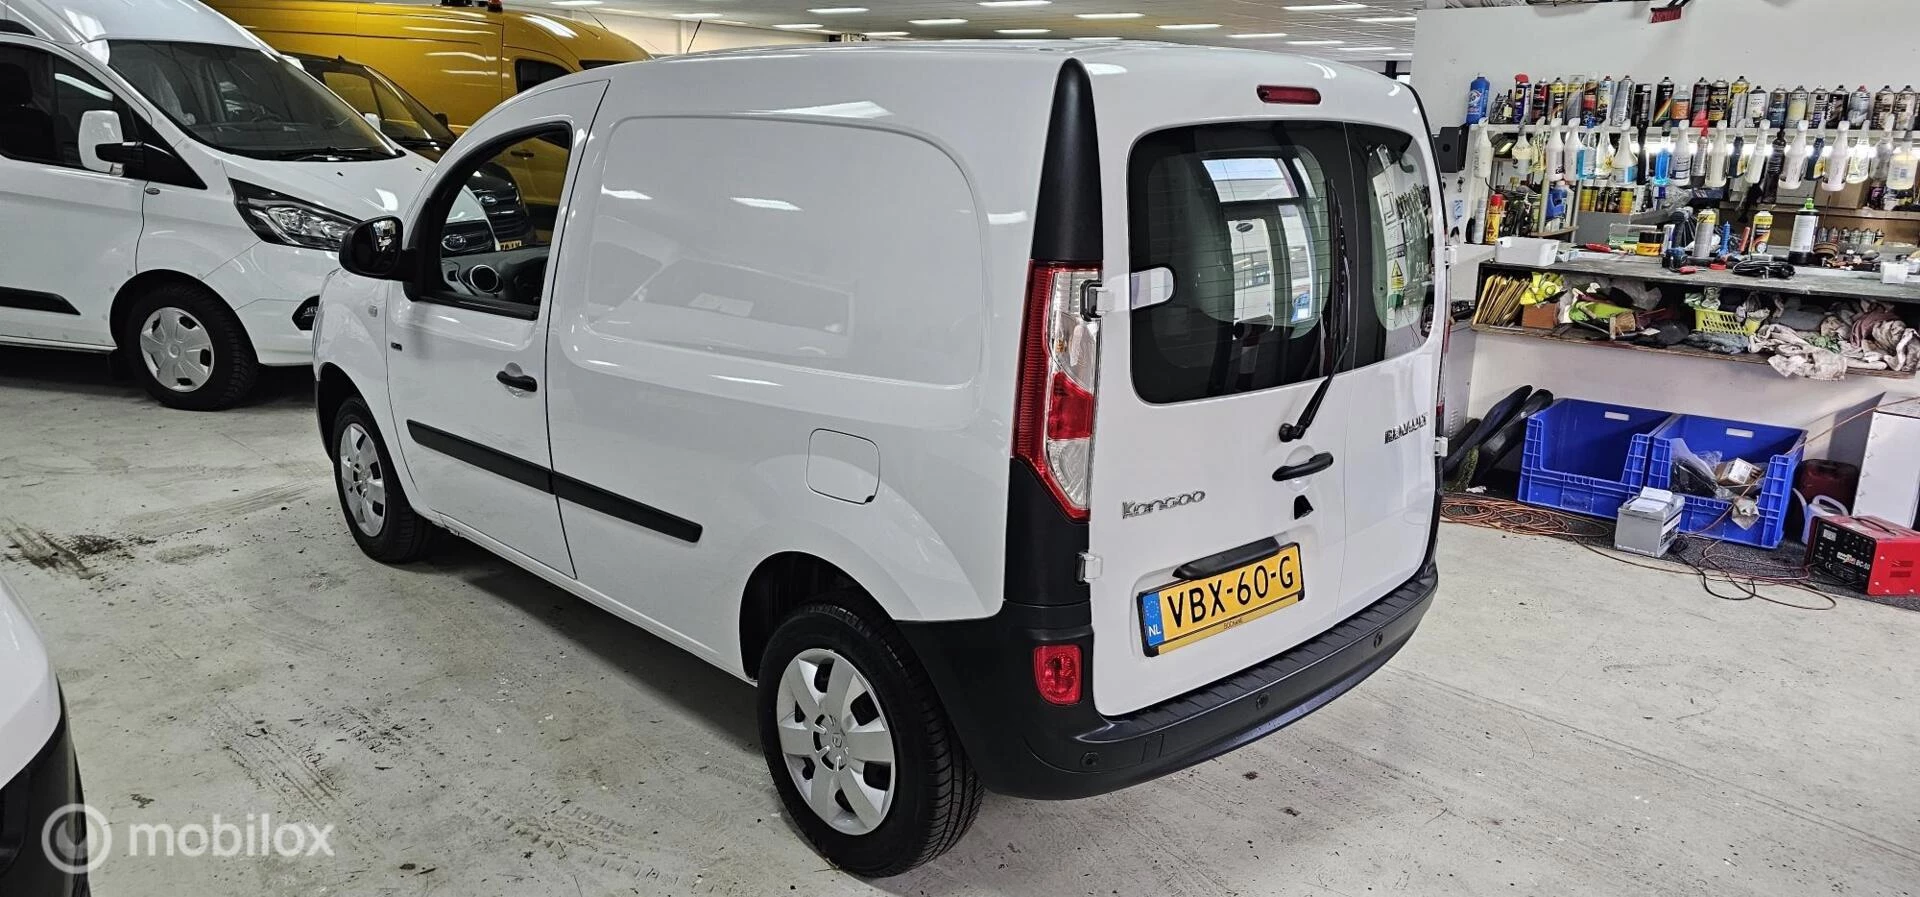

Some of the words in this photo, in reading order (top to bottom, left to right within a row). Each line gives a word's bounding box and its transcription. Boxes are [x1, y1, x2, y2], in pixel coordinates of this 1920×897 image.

[1122, 491, 1206, 519] Kangoo
[1167, 555, 1294, 628] VBX-60-G
[1148, 625, 1162, 637] NL
